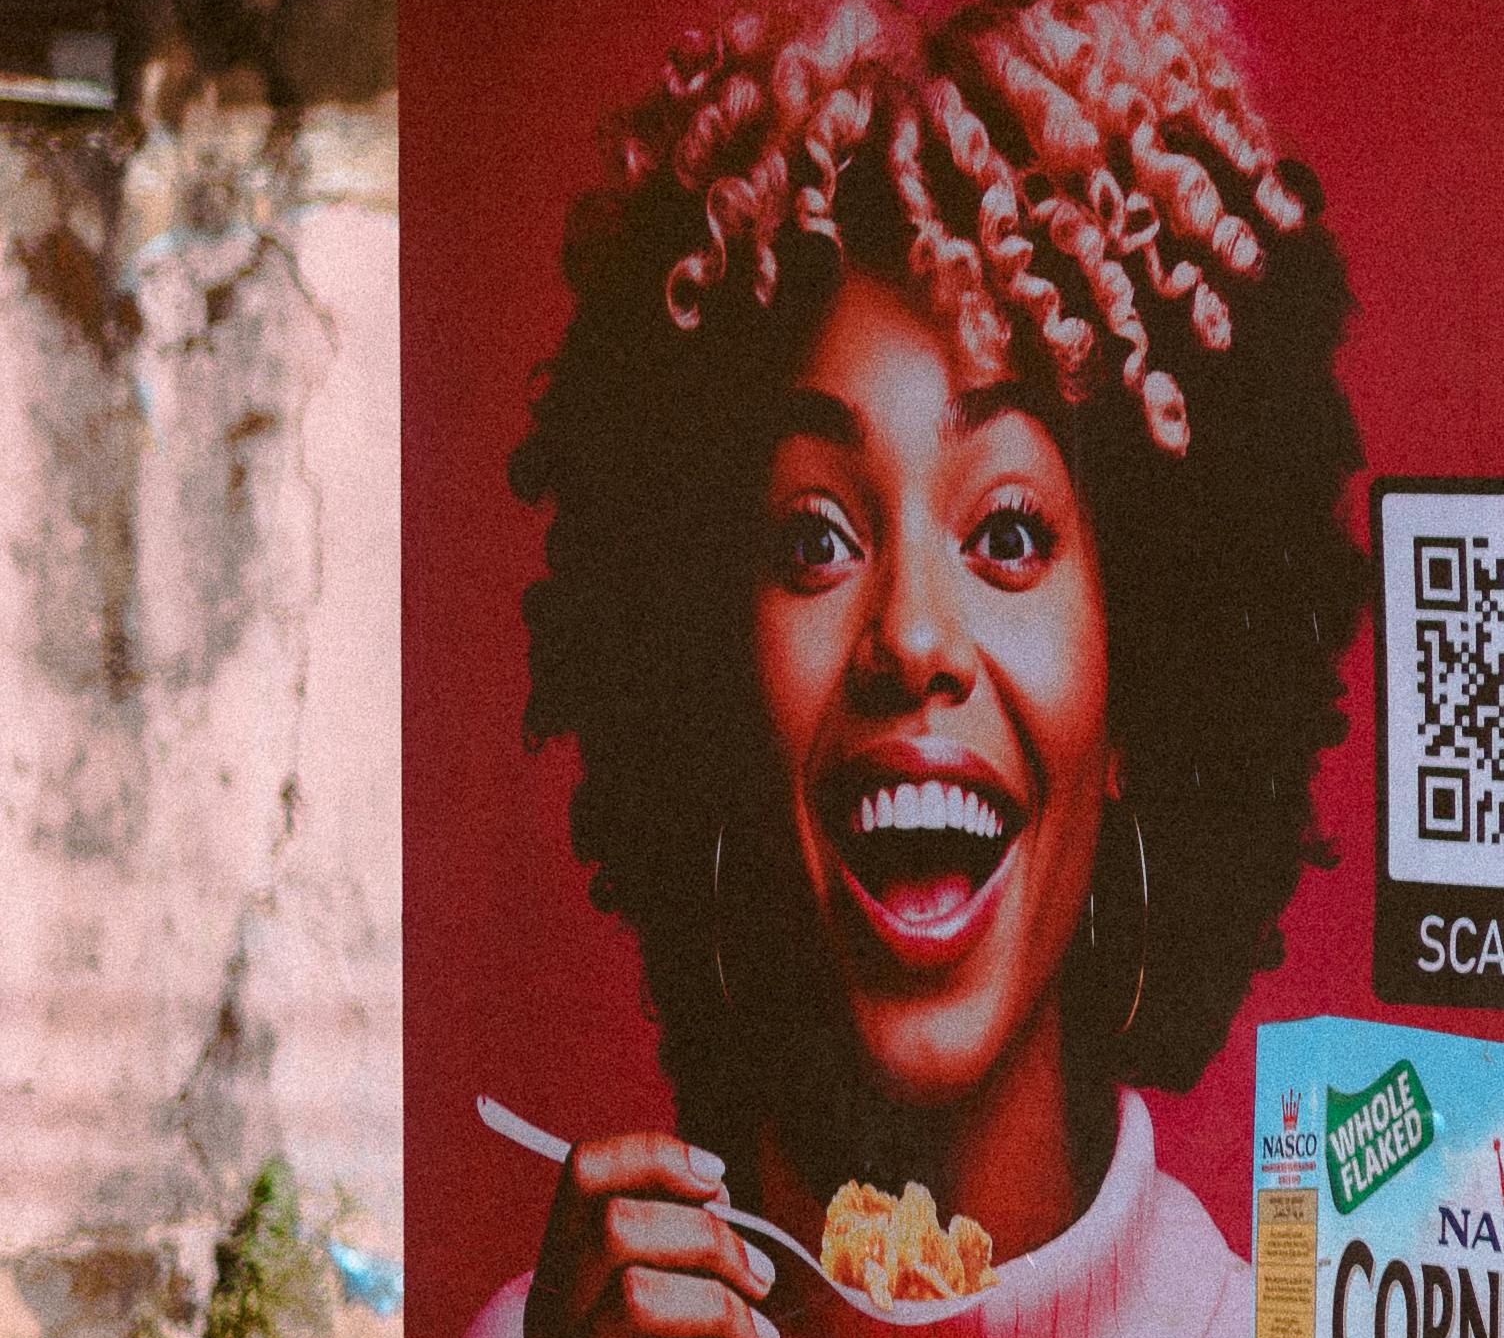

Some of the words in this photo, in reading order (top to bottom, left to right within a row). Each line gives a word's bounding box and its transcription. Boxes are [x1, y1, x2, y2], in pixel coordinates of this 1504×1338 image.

[1262, 1132, 1318, 1161] NASCO
[1329, 1069, 1415, 1164] WHOLE
[1340, 1108, 1423, 1203] FLAKED
